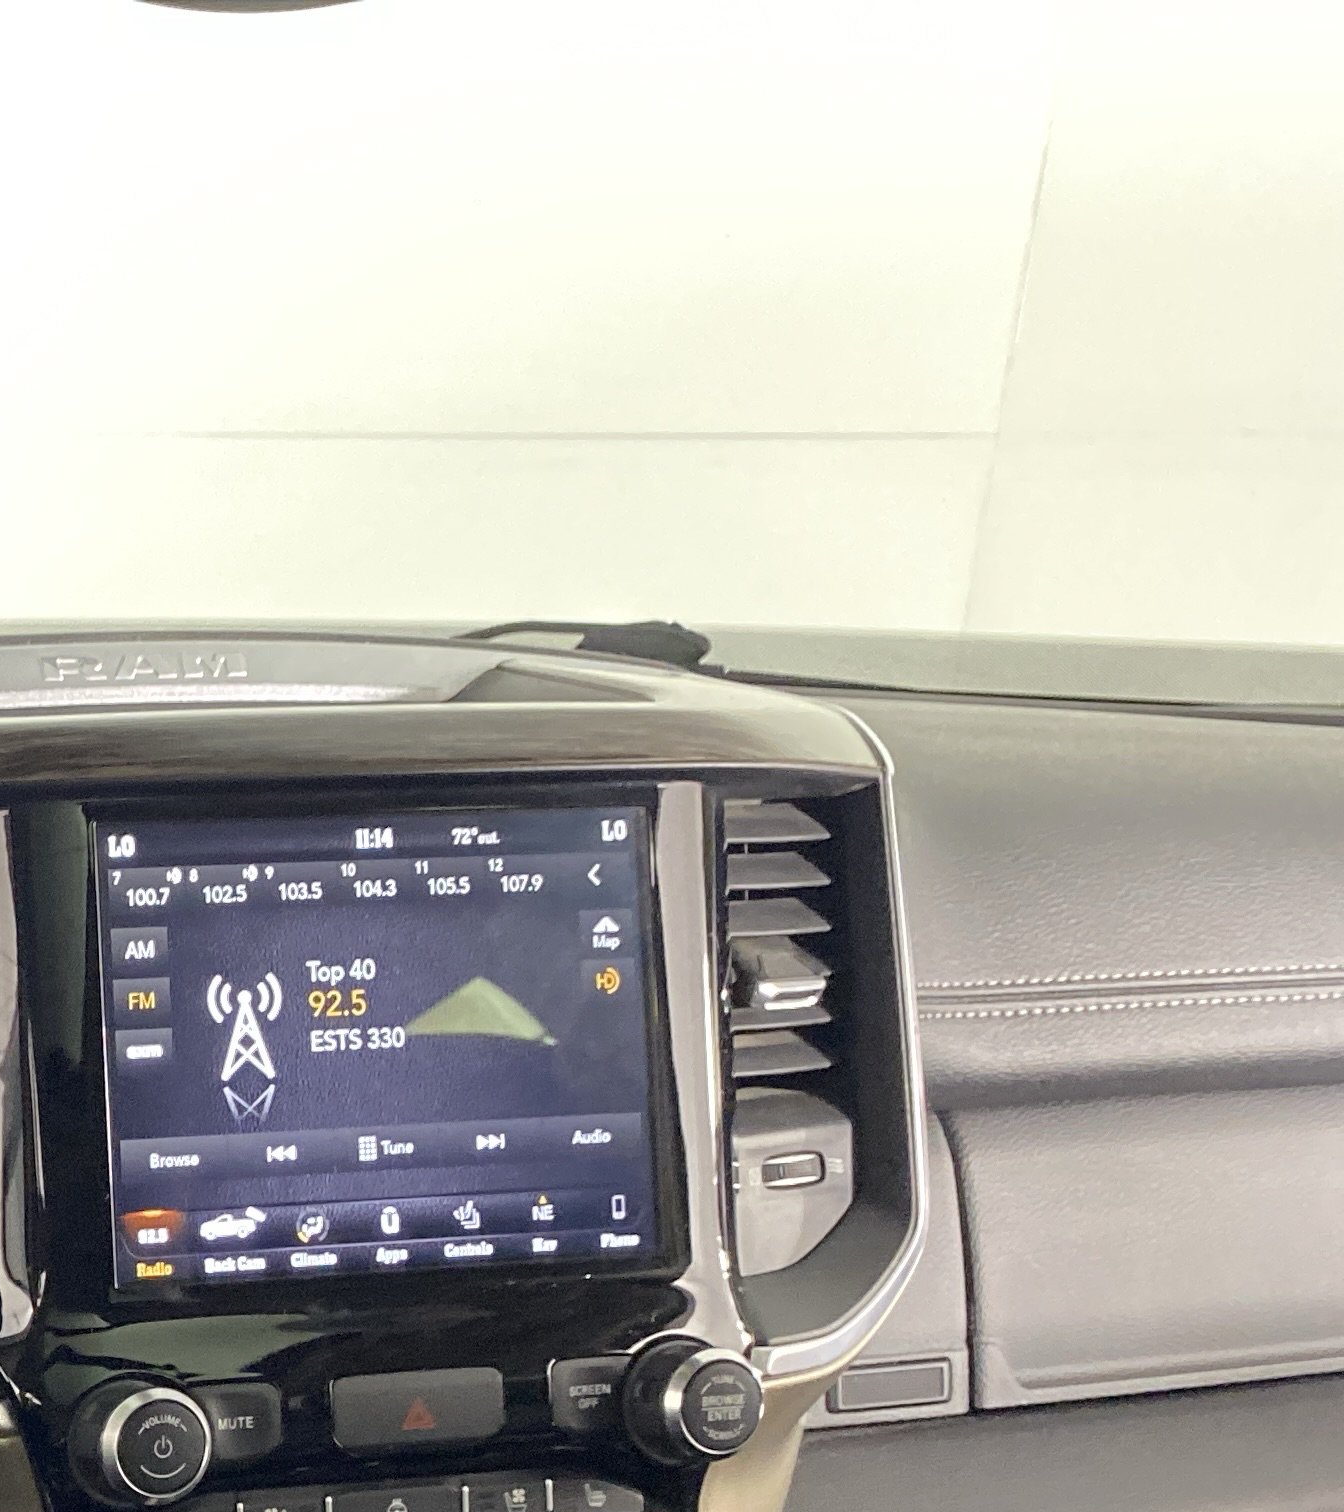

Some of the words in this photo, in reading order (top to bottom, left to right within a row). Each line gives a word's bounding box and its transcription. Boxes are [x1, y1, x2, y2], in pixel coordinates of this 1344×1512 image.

[39, 652, 247, 681] RAM
[355, 827, 394, 849] 11:14
[265, 866, 274, 879] 9
[340, 863, 356, 878] 10
[414, 860, 428, 874] 11
[487, 858, 504, 872] 12
[112, 871, 121, 885] 7
[189, 868, 198, 882] 8
[500, 874, 544, 892] 107.9
[202, 884, 247, 904] 102.5
[278, 882, 323, 900] 103.5
[353, 879, 397, 898] 104.3
[427, 876, 470, 895] 105.5
[126, 887, 170, 907] 100.7
[124, 940, 155, 960] AM
[305, 960, 345, 986] Top
[349, 958, 376, 980] 40
[128, 991, 156, 1010] FM
[308, 989, 367, 1017] 92.5
[310, 1029, 362, 1052] ESTS
[367, 1026, 405, 1048] 330
[572, 1128, 611, 1145] Audio
[380, 1140, 413, 1155] Tune
[149, 1152, 199, 1169] Browse
[532, 1204, 555, 1221] NE
[136, 1261, 173, 1277] Radio
[142, 1415, 181, 1429] VOLUME
[218, 1416, 255, 1431] MUTE
